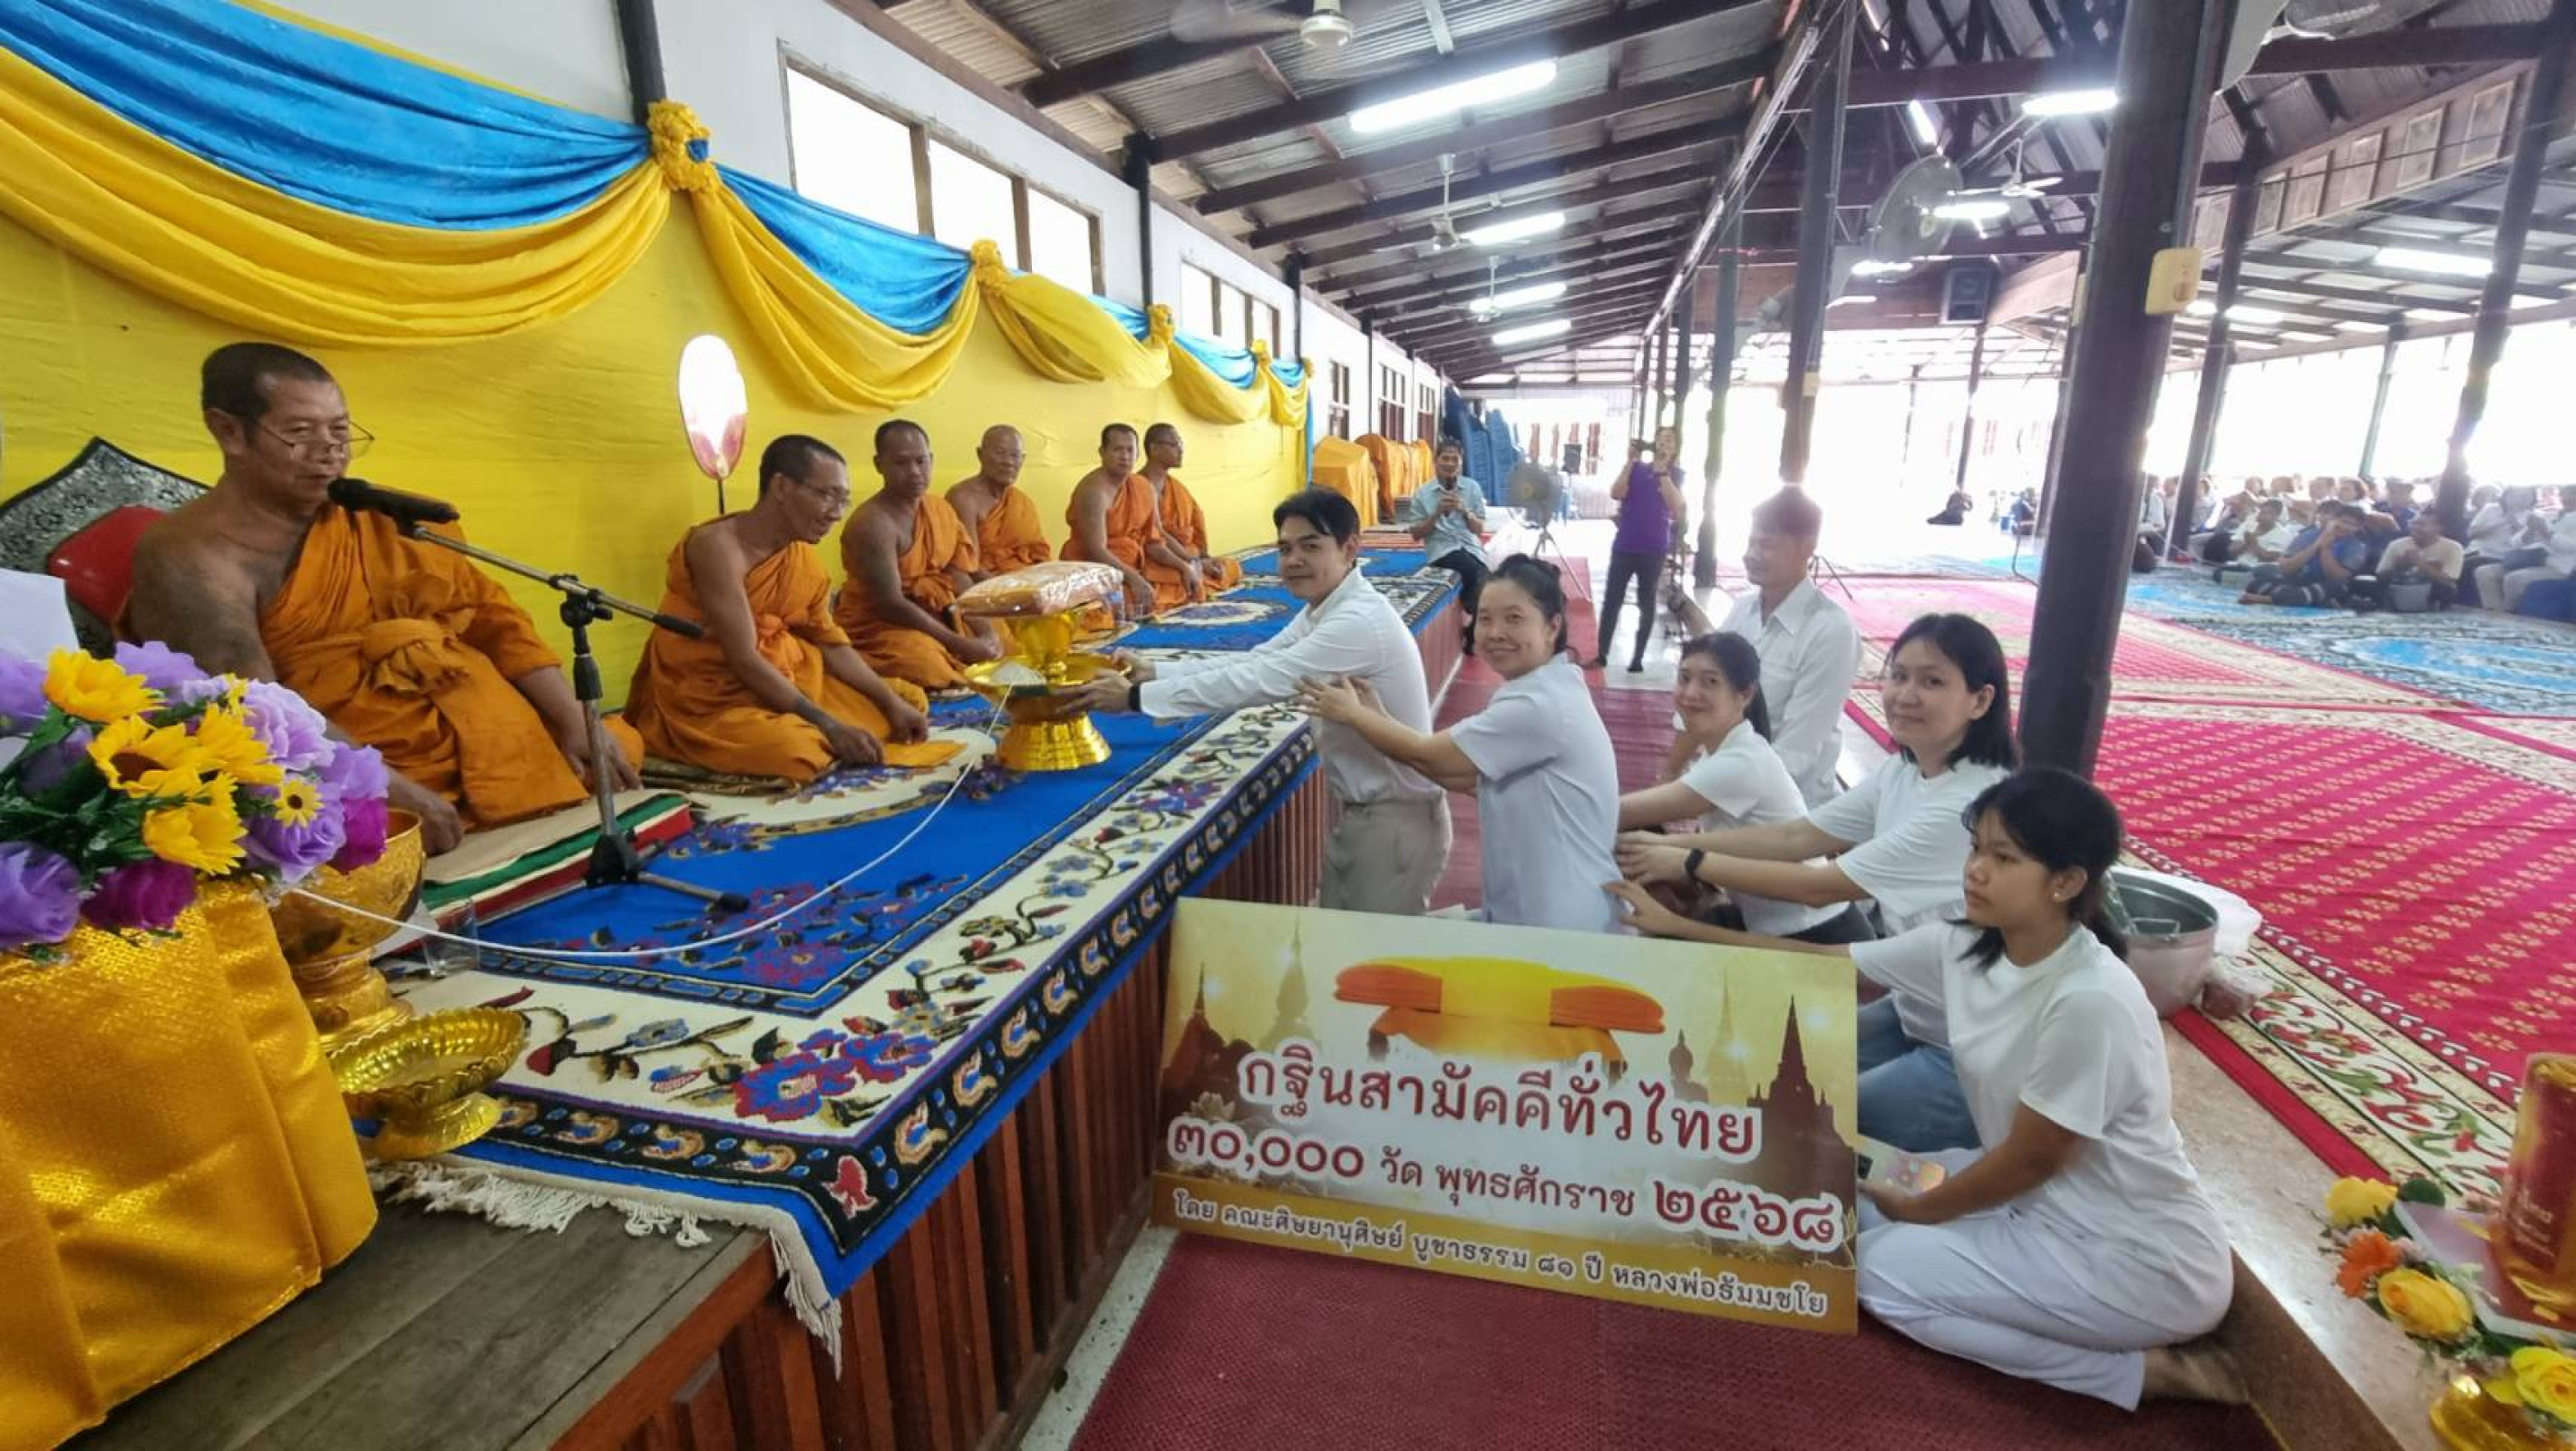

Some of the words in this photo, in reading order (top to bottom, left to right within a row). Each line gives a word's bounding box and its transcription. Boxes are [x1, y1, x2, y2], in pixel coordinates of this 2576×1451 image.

[1246, 1044, 1754, 1155] กฐินสามัคคีทั่วไทย
[1174, 1124, 1365, 1178] ๓๐,๐๐๐
[1380, 1144, 1423, 1187] วัด
[1434, 1163, 1636, 1217] พุทธศักราช
[1652, 1180, 1836, 1244] ๒๕๖๘
[1176, 1190, 1216, 1220] โดย
[1224, 1206, 1404, 1249] คณะศิษยานุศิษย์
[1413, 1233, 1528, 1270] บูชาธรรม
[1584, 1254, 1602, 1281] ปี
[1613, 1266, 1826, 1314] หลวงพ่อธัมมชโย
